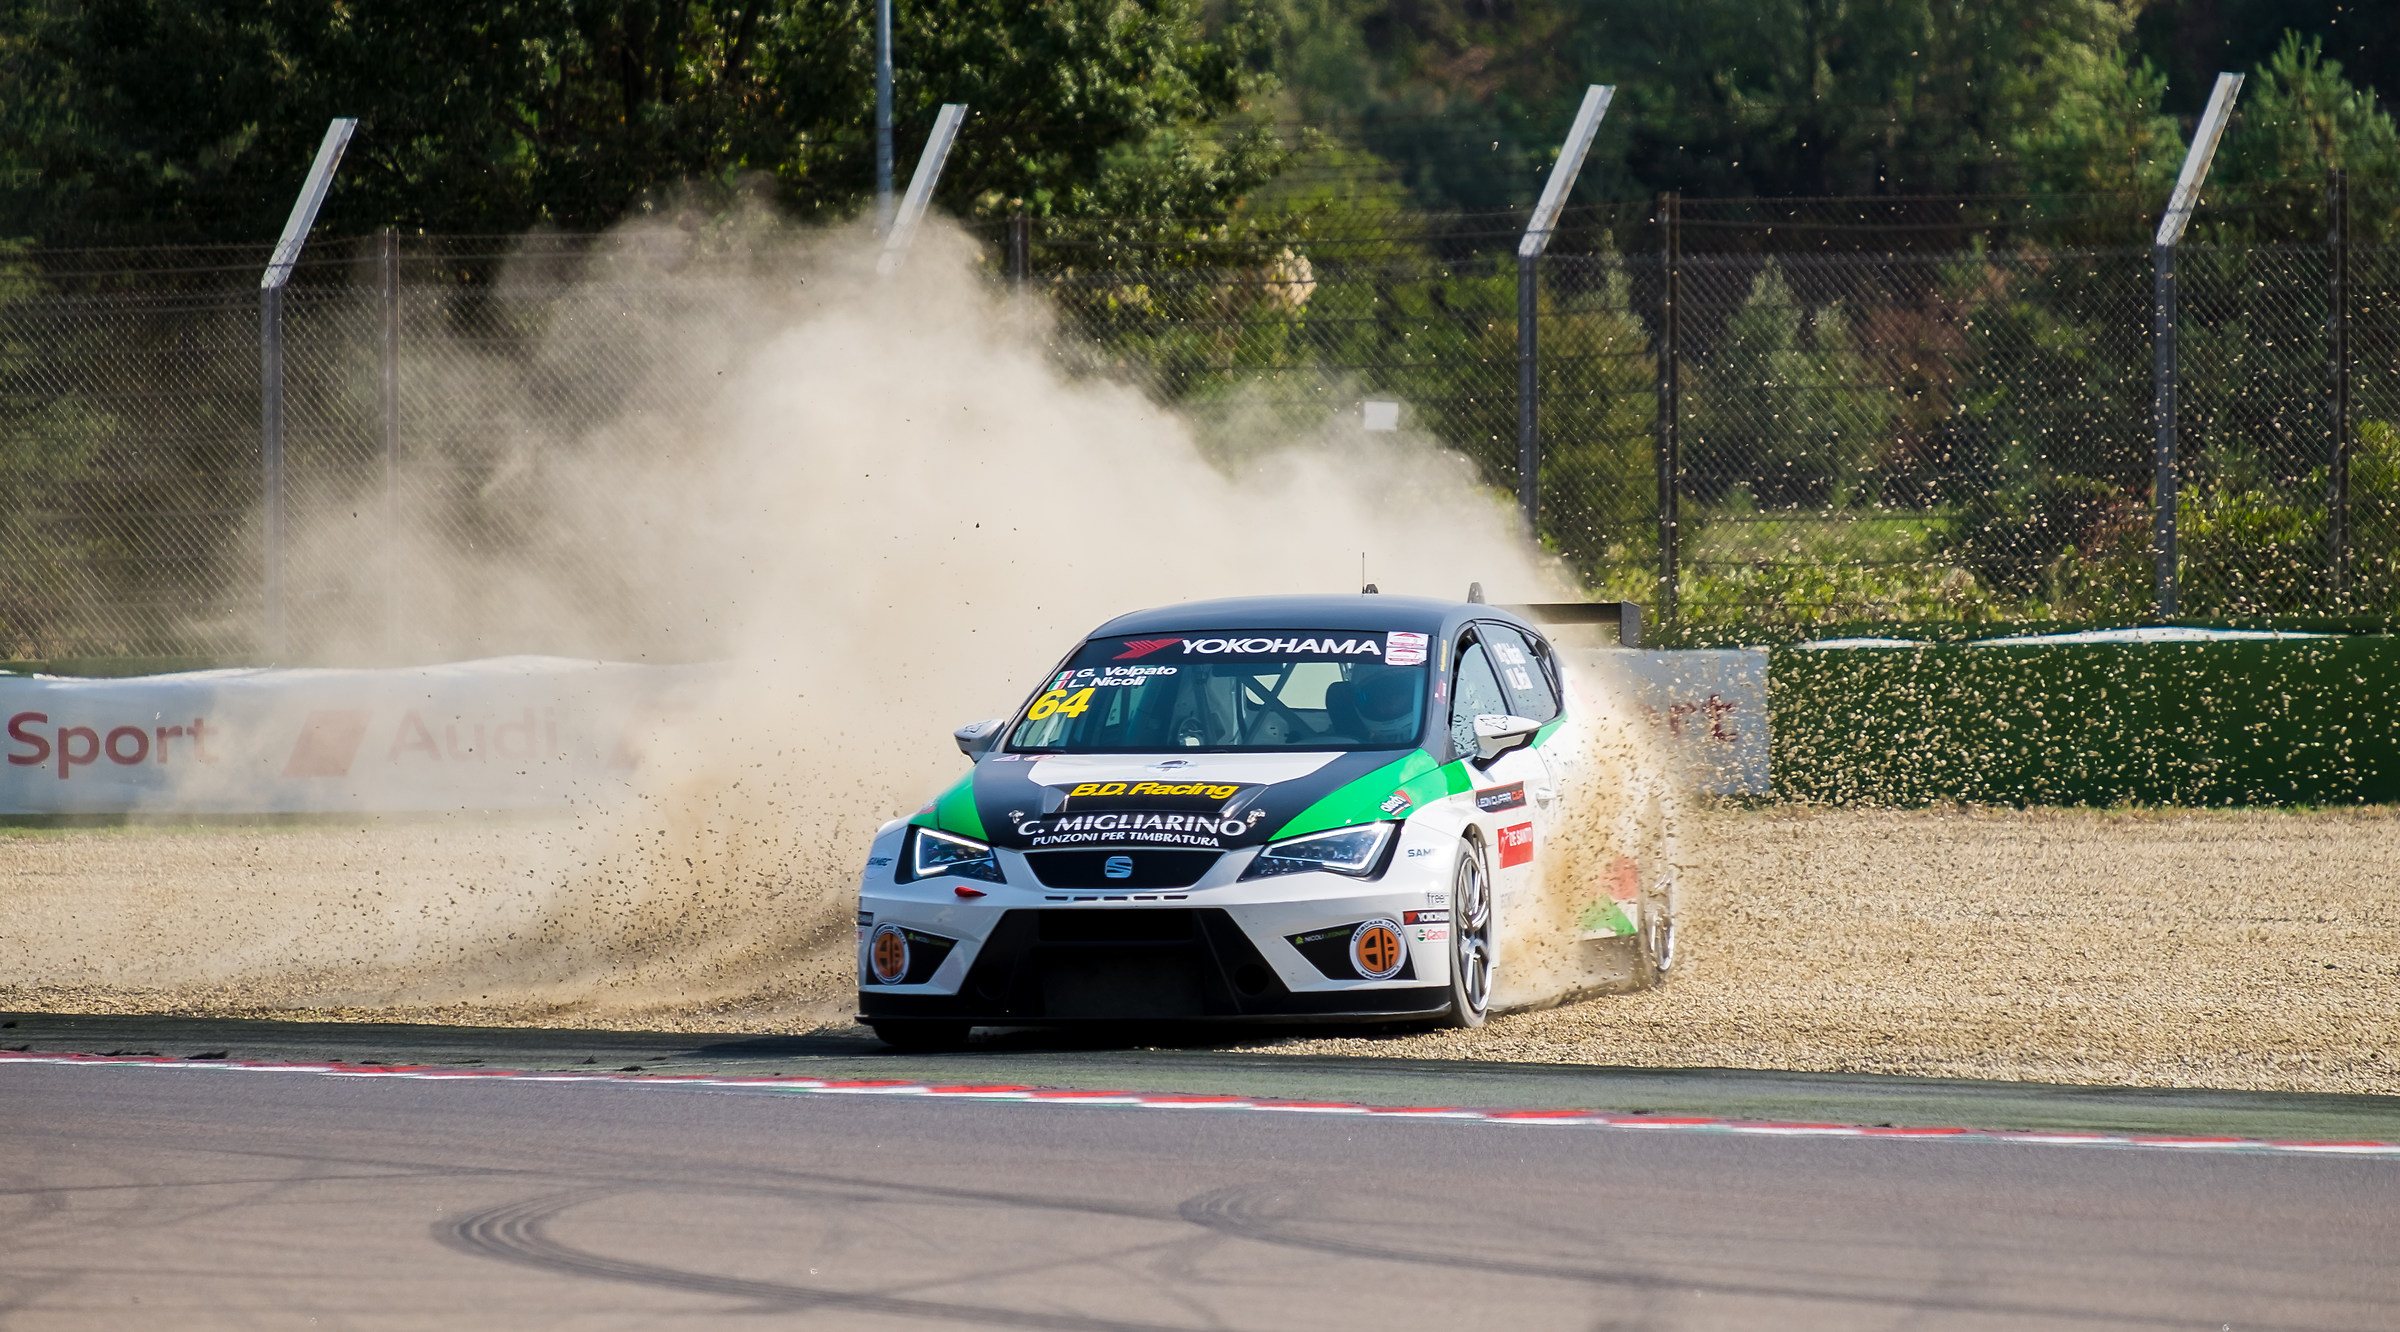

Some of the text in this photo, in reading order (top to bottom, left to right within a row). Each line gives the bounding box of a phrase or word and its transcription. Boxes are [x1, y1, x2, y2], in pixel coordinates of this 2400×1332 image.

[1182, 638, 1382, 655] YOKOHAMA
[1076, 665, 1177, 678] G. Volpato
[1067, 676, 1146, 688] L. Nicoli
[1027, 687, 1096, 721] 64
[388, 706, 559, 762] Audi
[7, 711, 220, 780] Sport
[1069, 782, 1239, 800] B.D. Racing
[1018, 814, 1247, 837] C. MIGLIARINO
[1032, 831, 1219, 847] PUNZONI PER TIMBRATURA
